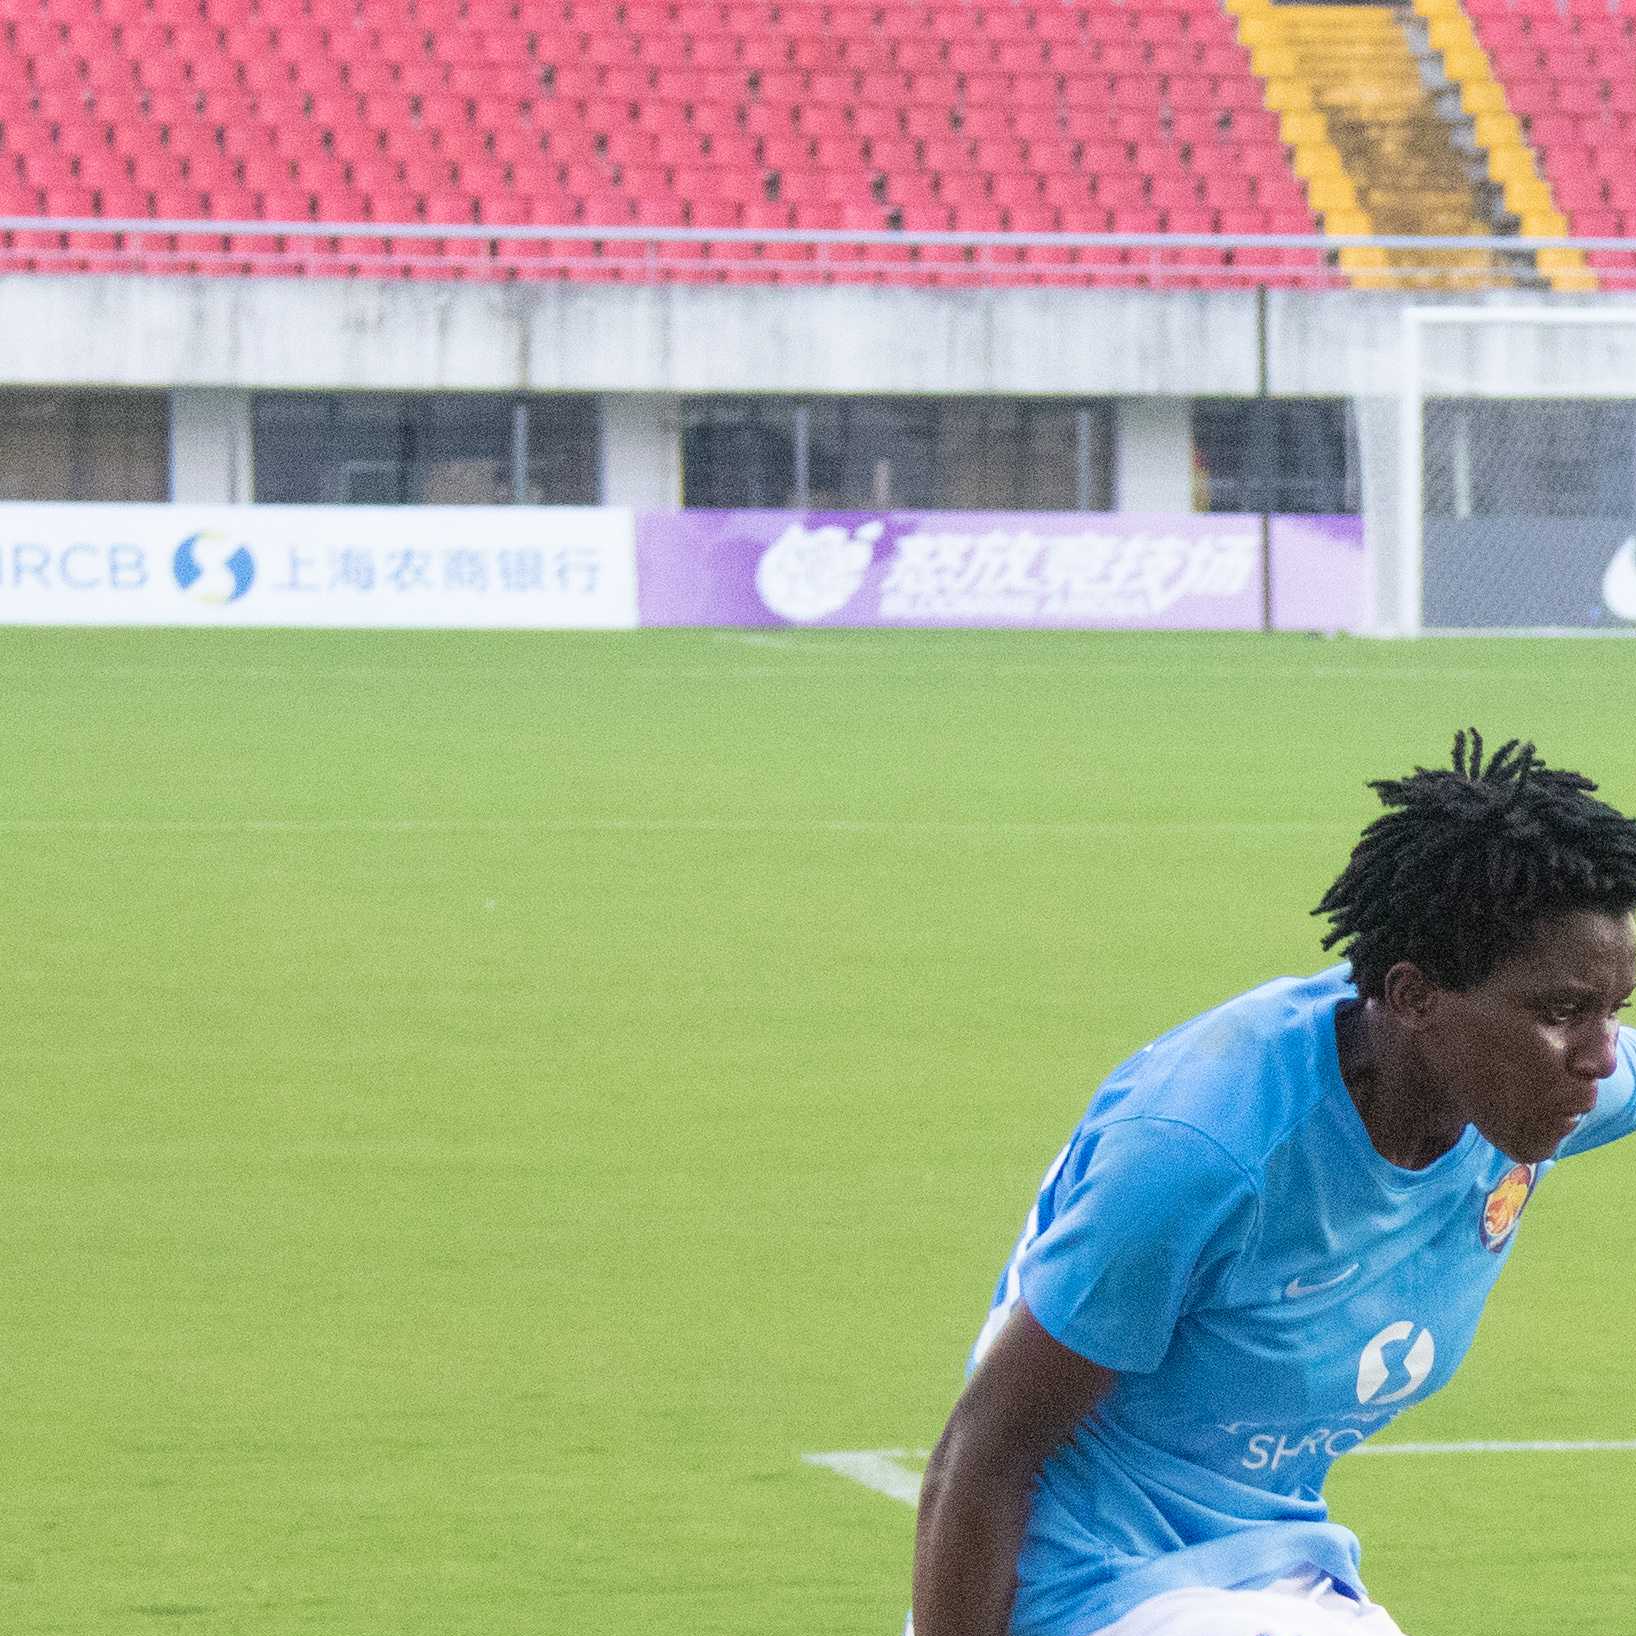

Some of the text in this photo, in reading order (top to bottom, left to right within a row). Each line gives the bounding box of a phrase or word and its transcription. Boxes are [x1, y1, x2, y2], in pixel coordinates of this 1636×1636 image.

[272, 546, 602, 594] 上海农商银行
